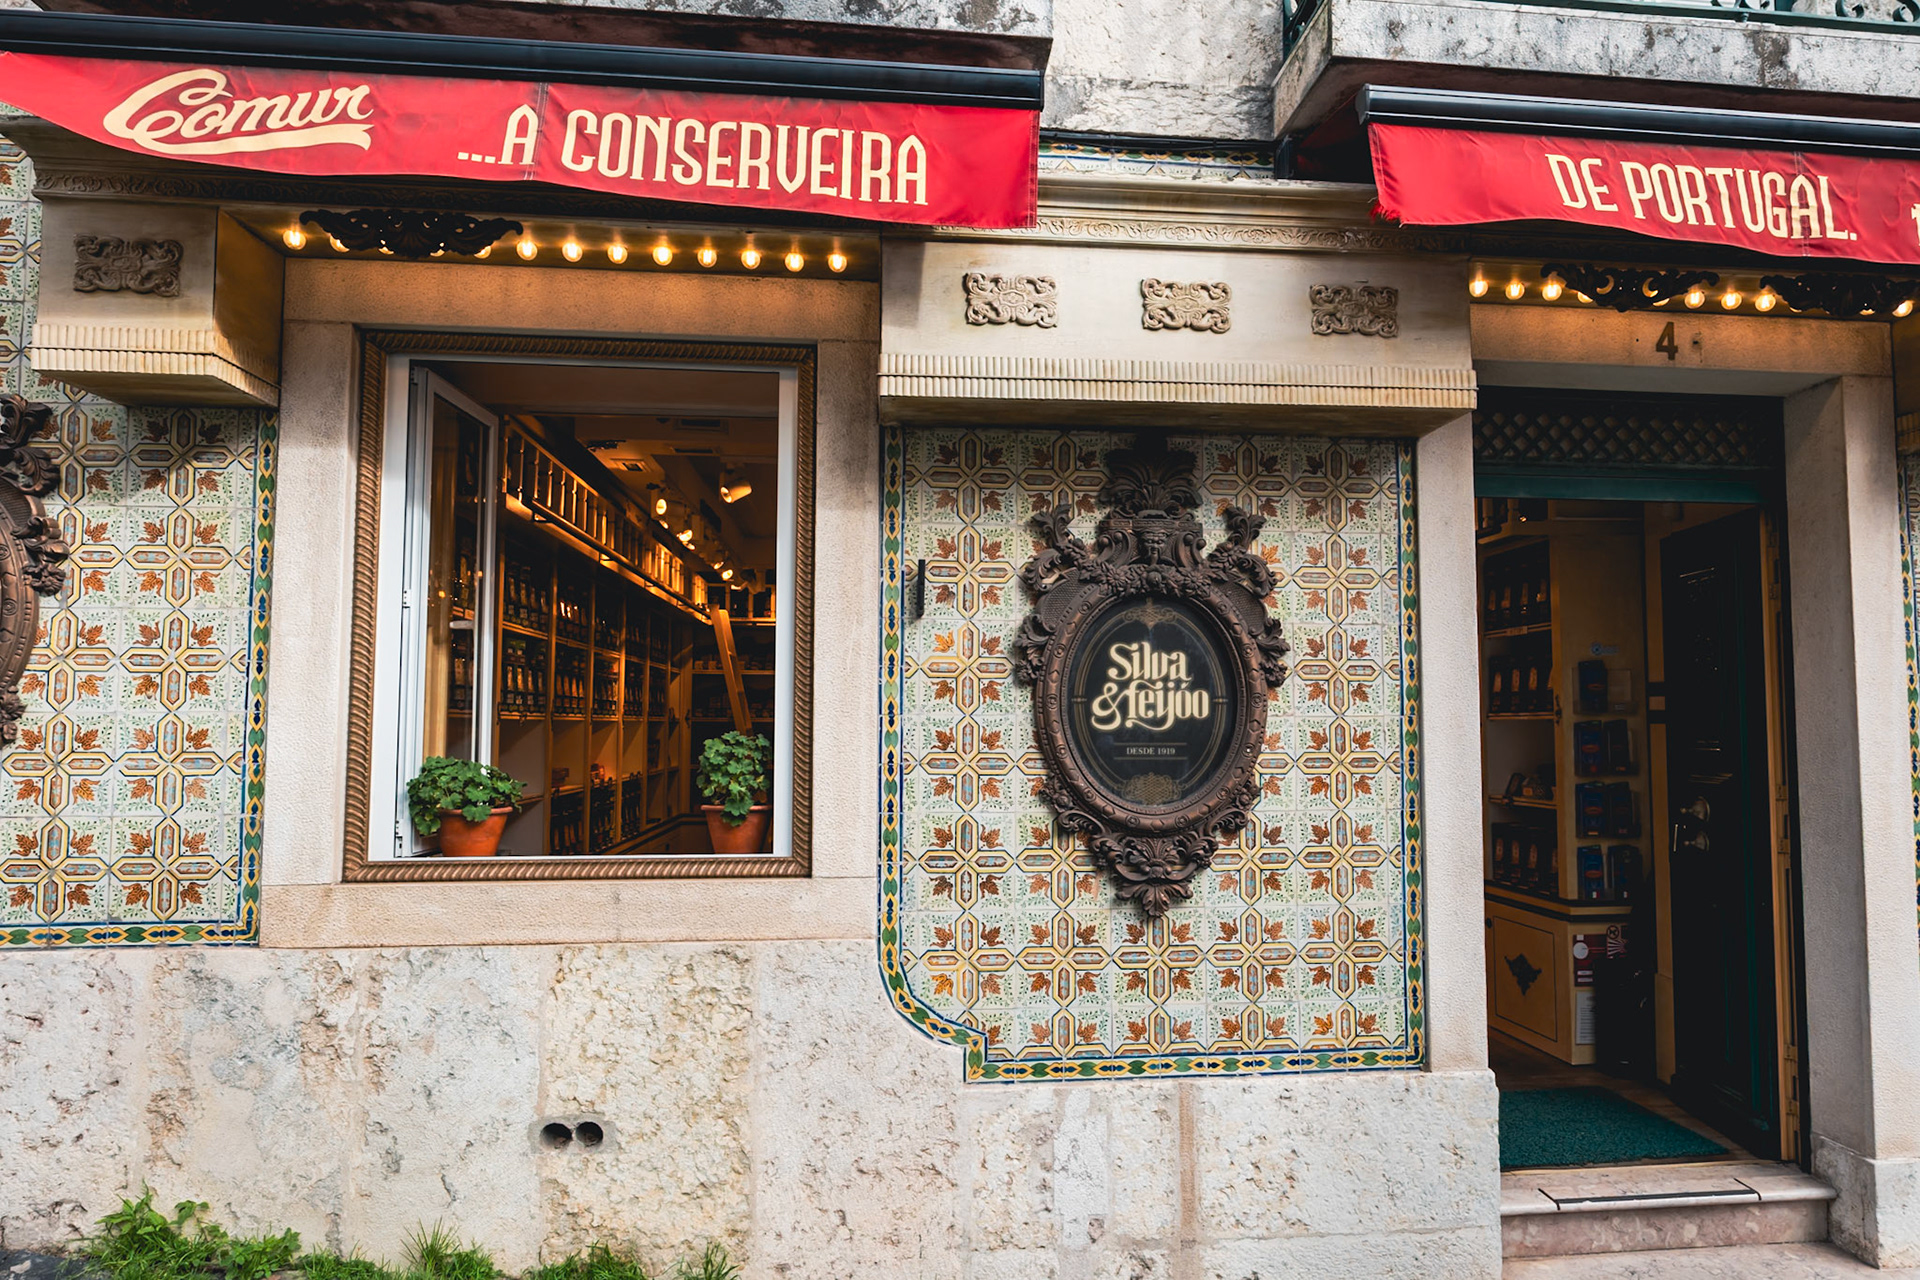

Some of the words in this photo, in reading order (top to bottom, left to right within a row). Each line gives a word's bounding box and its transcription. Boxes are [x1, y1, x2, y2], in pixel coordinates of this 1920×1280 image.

[103, 69, 374, 155] Comur
[561, 109, 928, 205] CONSERVEIRA
[1545, 154, 1618, 211] DE
[1620, 161, 1857, 240] PORTUGAL.
[1656, 322, 1678, 361] 4
[1107, 641, 1192, 681] Silva
[1091, 682, 1122, 731] &
[1126, 747, 1155, 755] DESDE
[1157, 747, 1176, 755] 1919
